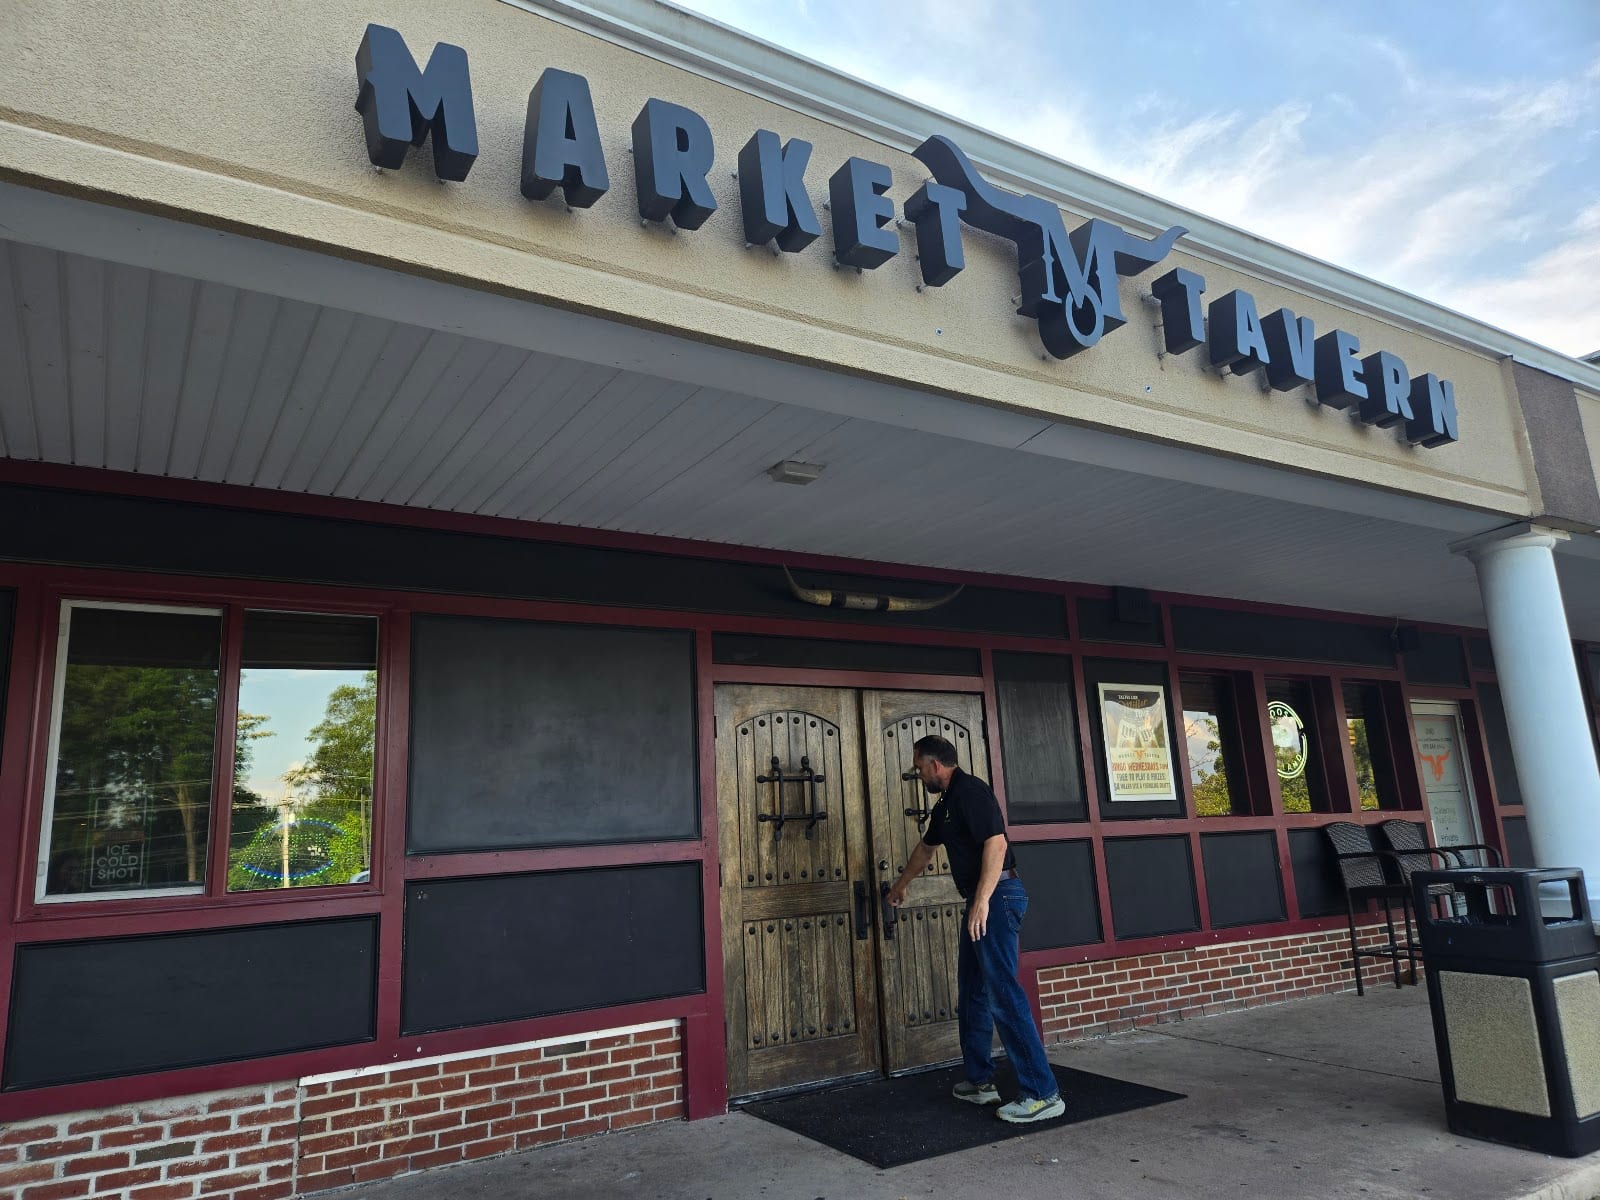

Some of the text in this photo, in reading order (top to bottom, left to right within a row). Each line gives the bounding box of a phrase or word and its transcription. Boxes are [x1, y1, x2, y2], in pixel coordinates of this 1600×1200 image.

[355, 23, 967, 288] MARKET
[1151, 267, 1460, 449] TAVERN
[107, 844, 130, 855] ICE
[96, 855, 139, 868] COLD
[97, 867, 138, 880] SHOT
